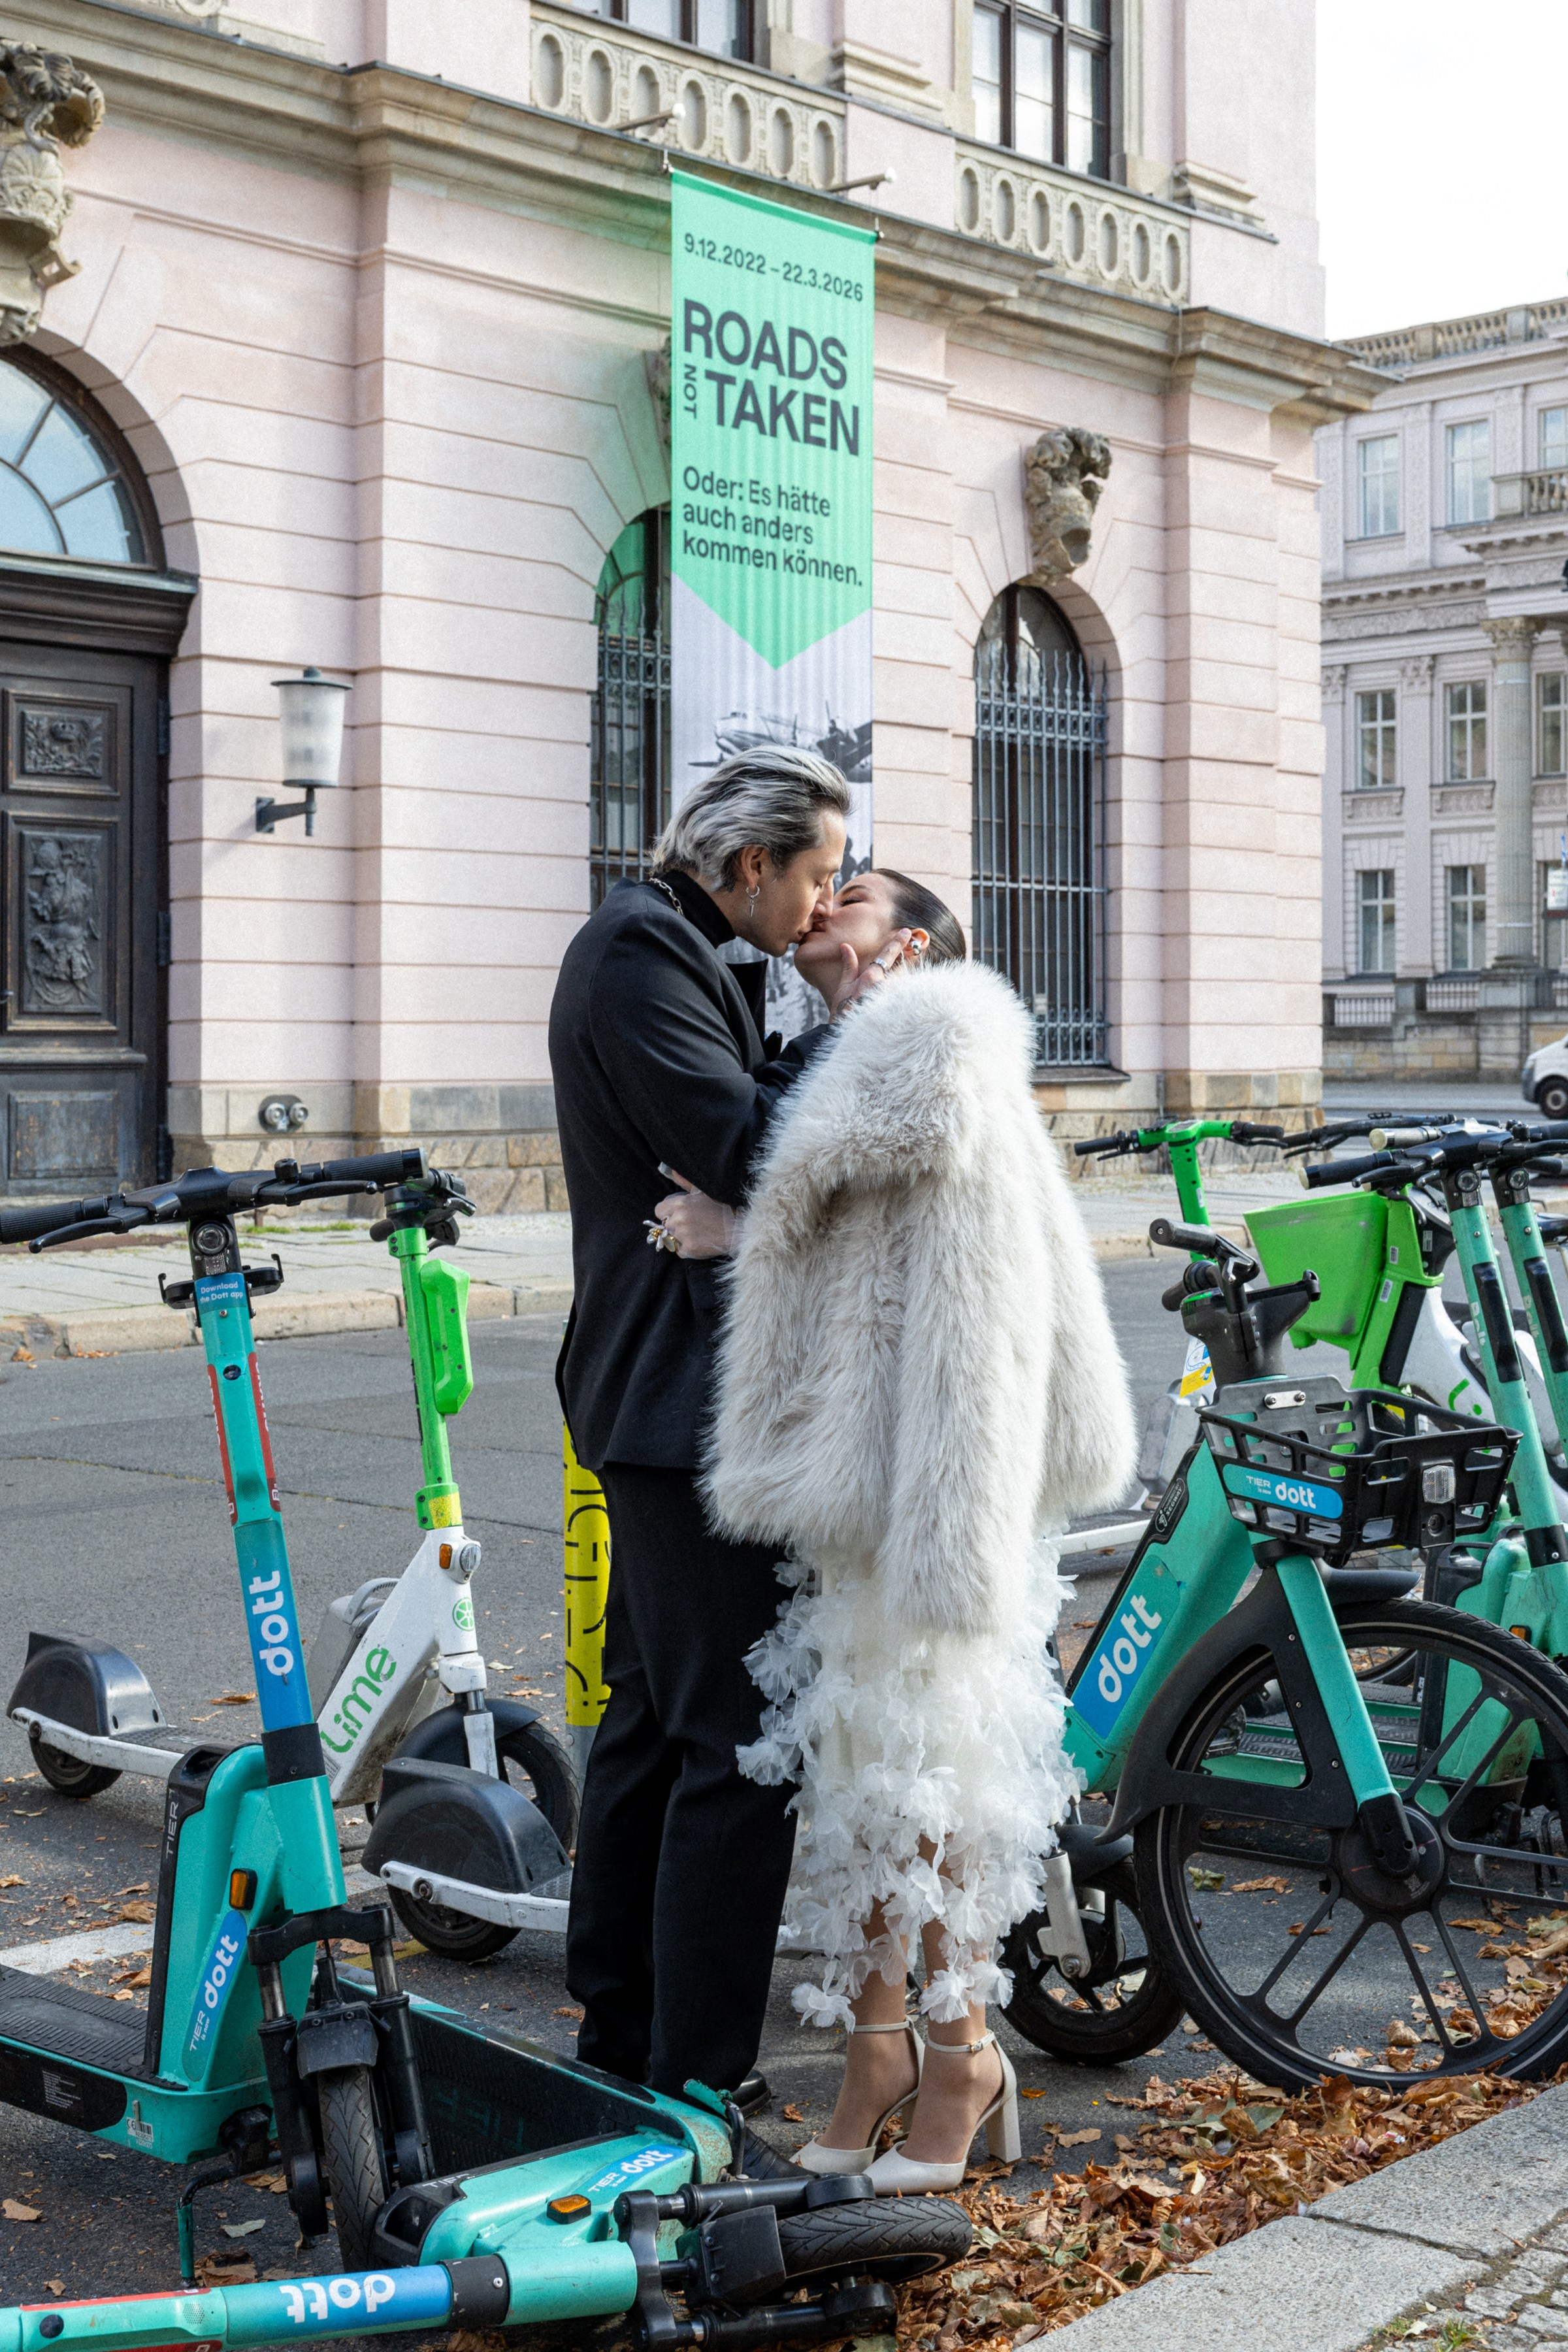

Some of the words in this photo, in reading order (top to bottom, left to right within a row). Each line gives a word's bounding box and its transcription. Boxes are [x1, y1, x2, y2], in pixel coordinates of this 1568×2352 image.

[683, 298, 847, 390] ROADS
[683, 363, 697, 419] NOT
[704, 369, 859, 456] TAKEN
[683, 466, 743, 501] Oder:
[748, 480, 772, 506] Es
[777, 483, 830, 517] hätte
[683, 501, 736, 532] auch
[742, 510, 813, 545] anders
[683, 530, 777, 572] kommen
[783, 547, 863, 587] können.
[201, 1281, 238, 1294] Download
[210, 1292, 229, 1301] Dott
[1166, 1486, 1183, 1516] SEGWAY
[1246, 1475, 1271, 1488] TIER
[1275, 1481, 1316, 1509] dott
[249, 1570, 294, 1676] dott
[1098, 1594, 1162, 1703] dott
[165, 1801, 180, 1859] TIER
[204, 1935, 239, 2009] dott
[189, 2010, 205, 2051] TIER
[587, 2172, 620, 2193] TIER
[621, 2149, 674, 2173] dott
[280, 2274, 396, 2323] dott
